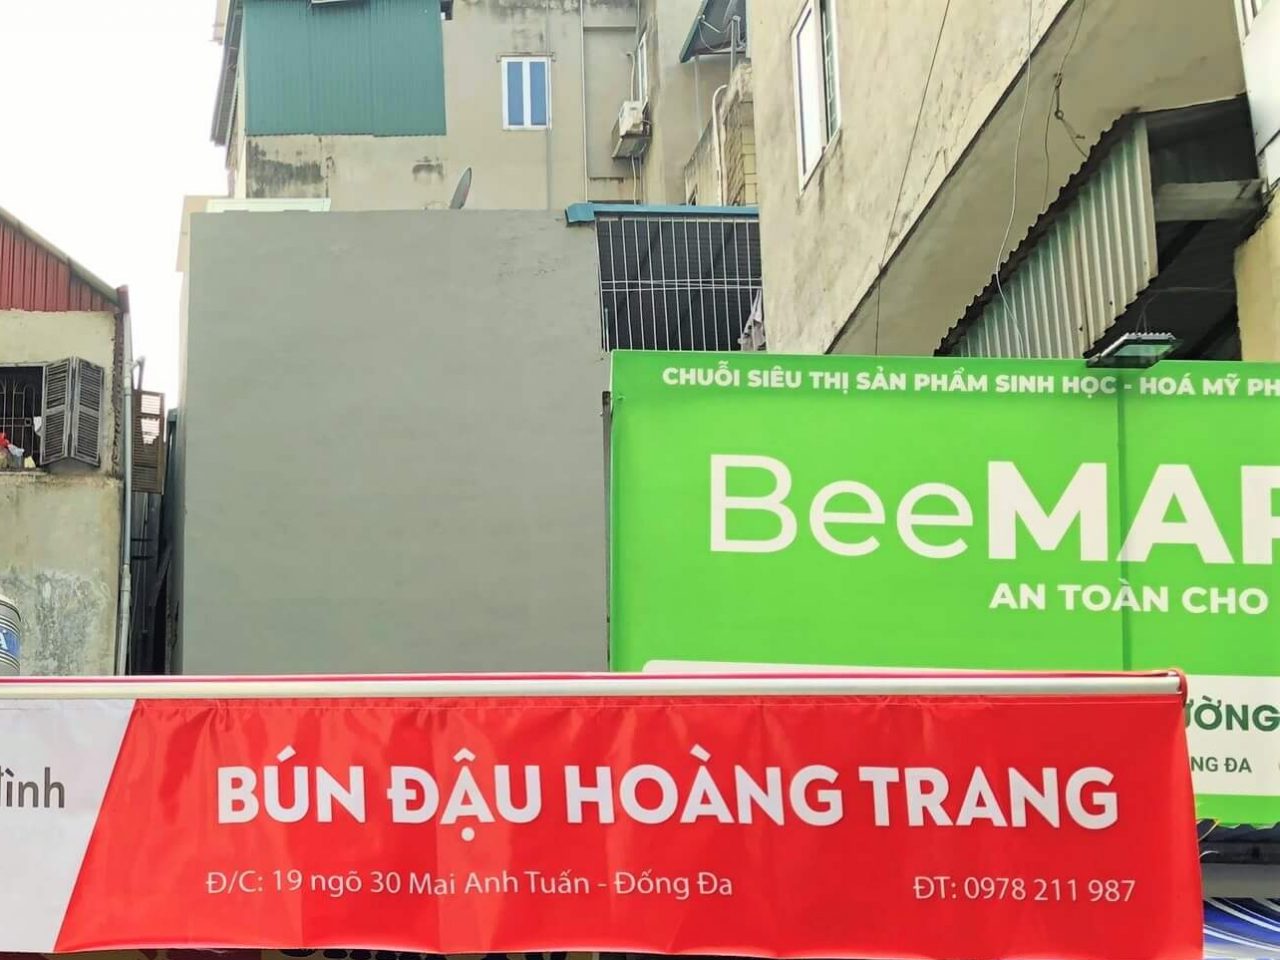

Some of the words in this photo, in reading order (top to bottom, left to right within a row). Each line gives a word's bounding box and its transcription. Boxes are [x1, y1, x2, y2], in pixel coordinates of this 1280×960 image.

[662, 360, 740, 388] CHUỖI
[747, 366, 802, 389] SIÊU
[809, 371, 849, 394] THỊ
[856, 366, 906, 391] SẢN
[914, 366, 988, 392] PHẨM
[995, 374, 1054, 393] SINH
[1062, 375, 1117, 398] HỌC
[1140, 373, 1196, 396] HOÁ
[1203, 373, 1241, 396] MỸ
[1247, 378, 1280, 397] PH
[989, 583, 1046, 611] AN
[1058, 577, 1169, 613] TOÀN
[1181, 586, 1269, 615] CHO
[1224, 757, 1252, 773] ĐA
[217, 744, 366, 824] BÚN
[387, 747, 543, 843] ĐẬU
[565, 743, 844, 827] HOÀNG
[857, 765, 1119, 830] TRANG
[205, 870, 264, 895] Đ/C:
[272, 869, 303, 892] 19
[310, 871, 363, 898] ngõ
[371, 871, 402, 894] 30
[408, 871, 456, 896] Mai
[463, 869, 519, 894] Anh
[524, 868, 590, 895] Tuấn
[613, 869, 690, 901] Đống
[697, 871, 733, 897] Đa
[912, 875, 958, 901] ĐT:
[964, 876, 1027, 901] 0978
[1033, 878, 1079, 901] 211
[1088, 879, 1136, 903] 987
